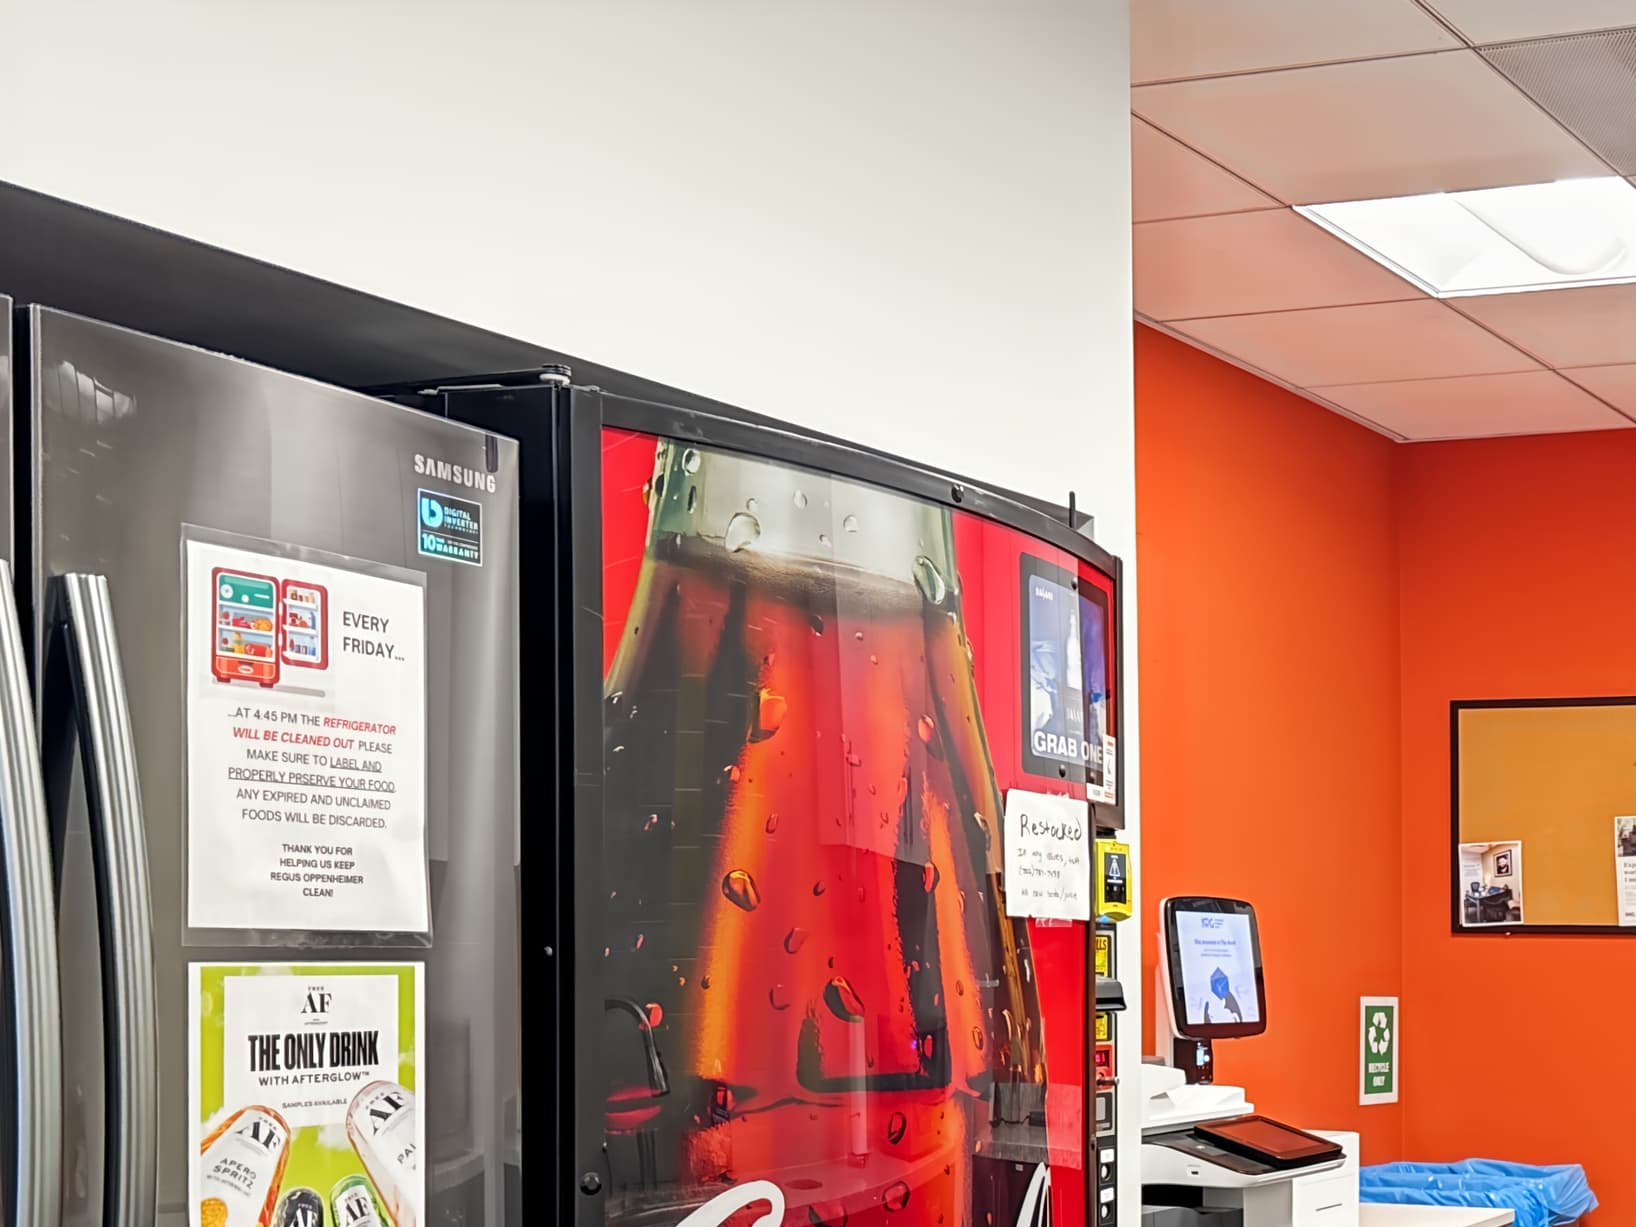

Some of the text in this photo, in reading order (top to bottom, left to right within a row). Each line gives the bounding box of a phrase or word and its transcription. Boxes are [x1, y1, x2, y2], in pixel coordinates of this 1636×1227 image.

[414, 454, 496, 493] SAMSUNG
[444, 506, 471, 520] DIGITAL
[444, 515, 479, 531] INVERTER
[342, 611, 389, 633] EVERY
[342, 636, 405, 662] FRIDAY...
[254, 709, 278, 722] 4:45
[281, 712, 298, 725] PM
[300, 714, 321, 727] THE
[323, 717, 397, 736] REFRIGERATOR
[233, 727, 393, 754] WILL BE CLEANED OUT PLEASE
[1033, 730, 1103, 765] GRAB ONE
[246, 749, 382, 772] MAKE SURE TO LABEL AND
[228, 767, 286, 781] PROPERLY
[288, 772, 336, 786] PRSERVE
[339, 777, 366, 788] YOUR
[236, 788, 391, 810] ANY EXPIRED AND UNCLAIMED
[242, 809, 388, 829] FOODS WILL BE DISCARDED.
[282, 844, 353, 856] THANK YOU FOR
[280, 858, 355, 870] HELPING US KEEP
[270, 872, 364, 884] REGUS OPPENHEIMER
[300, 992, 333, 1014] AF
[248, 1030, 379, 1072] THE ONLY DRINK
[258, 1075, 289, 1087] WITH
[282, 1098, 347, 1109] SAMPLES AVAILABLE
[213, 1165, 254, 1190] SPRITZ
